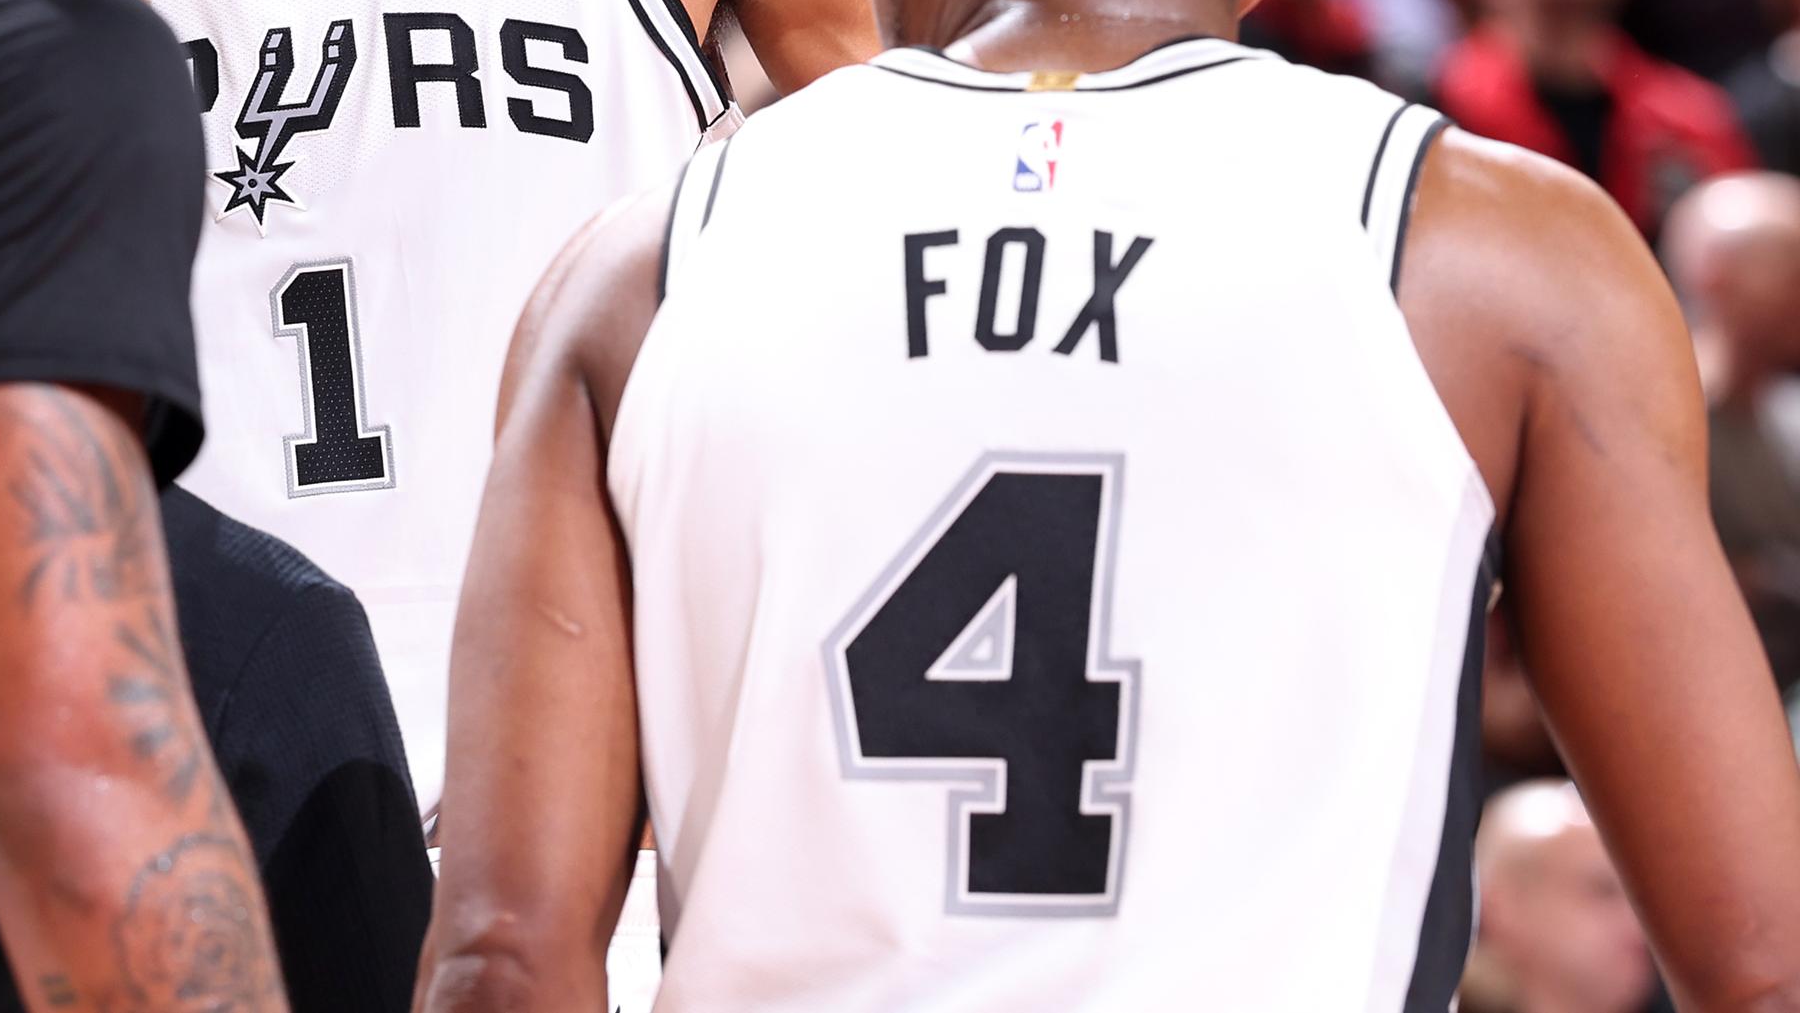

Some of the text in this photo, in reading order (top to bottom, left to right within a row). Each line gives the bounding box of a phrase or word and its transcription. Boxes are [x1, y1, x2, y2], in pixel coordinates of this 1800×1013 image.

[180, 12, 594, 226] URS
[269, 256, 396, 499] 1
[904, 227, 1155, 364] FOX
[821, 449, 1142, 917] 4
